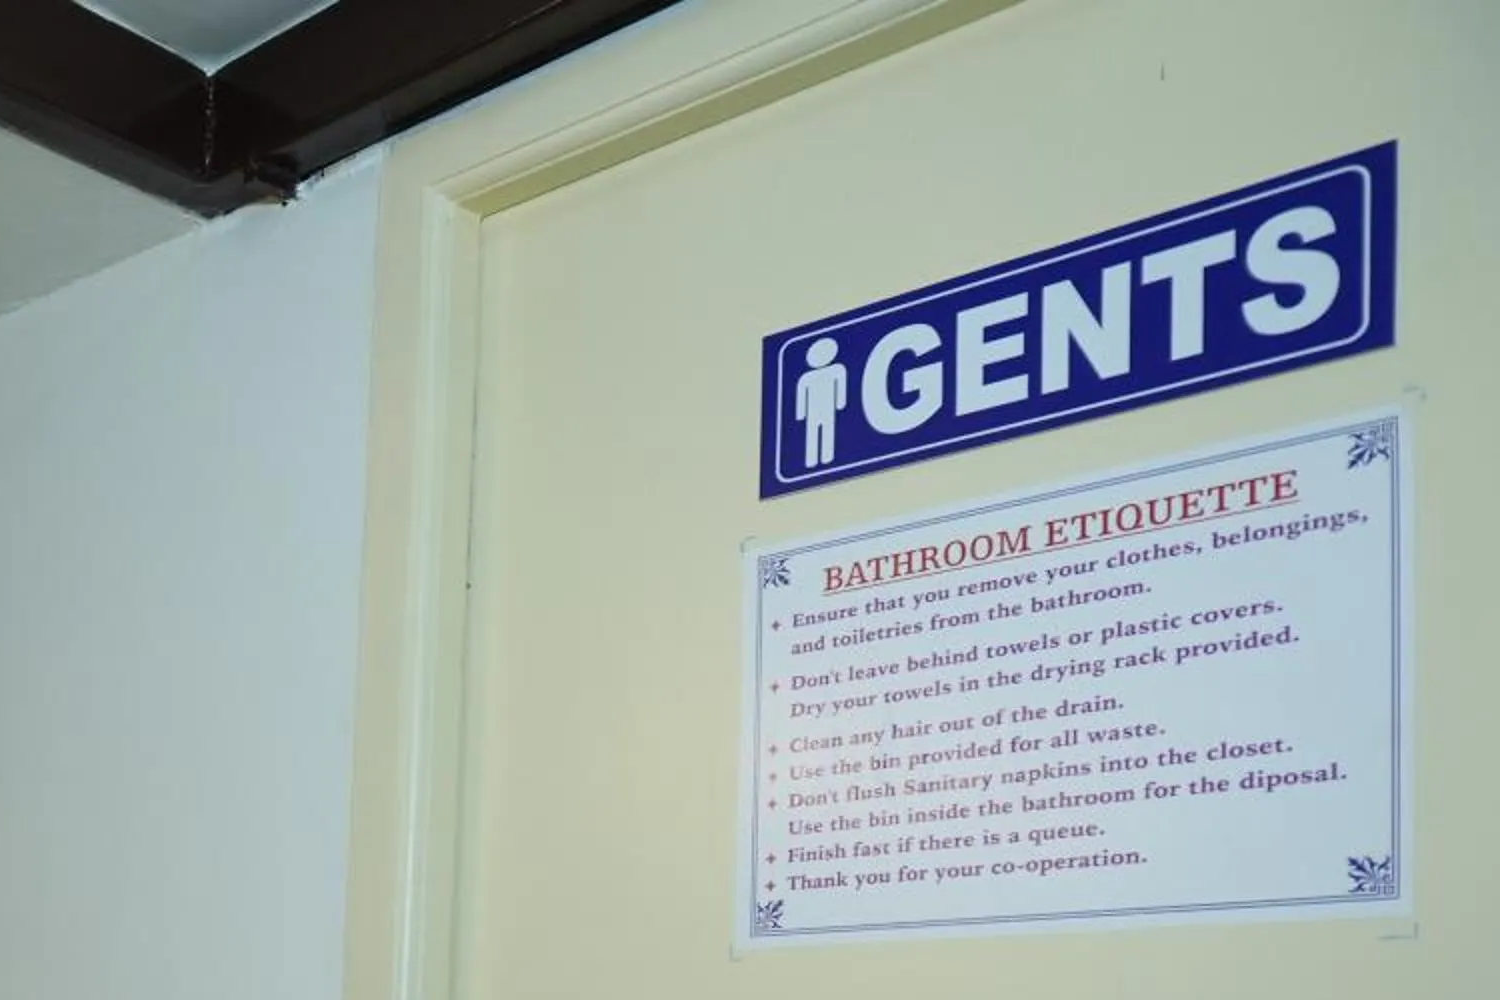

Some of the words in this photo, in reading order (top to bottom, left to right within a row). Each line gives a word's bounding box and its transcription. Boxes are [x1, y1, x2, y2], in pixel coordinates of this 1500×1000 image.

[861, 205, 1341, 435] GENTS
[823, 524, 1031, 592] BATHROOM
[1044, 468, 1298, 547] ETIQUETTE
[791, 606, 858, 628] Ensure
[864, 595, 904, 615] that
[912, 588, 950, 610] you
[956, 572, 1038, 597] remove
[1045, 559, 1098, 585] your
[1105, 542, 1202, 569] clothes,
[1211, 509, 1369, 549] belongings,
[790, 634, 825, 655] and
[831, 620, 923, 648] toiletries
[929, 611, 980, 631] from
[986, 601, 1022, 621] the
[1029, 581, 1152, 613] bathroom.
[847, 662, 899, 681] leave
[906, 644, 978, 673] behind
[985, 632, 1060, 659] towels
[1067, 630, 1093, 646] or
[1100, 612, 1181, 646] plastic
[1189, 601, 1283, 626] covers.
[789, 701, 826, 719] Dry
[831, 694, 877, 713] your
[882, 679, 952, 704] towels
[958, 675, 979, 693] in
[986, 670, 1022, 688] the
[1029, 658, 1105, 683] drying
[1113, 645, 1166, 669] rack
[1175, 624, 1300, 665] provided.
[788, 734, 843, 753] Clean
[848, 729, 885, 746] any
[890, 719, 932, 740] hair
[937, 716, 973, 733] out
[980, 708, 1003, 727] of
[1010, 704, 1047, 724] the
[1054, 694, 1124, 717] drain.
[788, 765, 824, 781] Use
[830, 758, 862, 775] the
[869, 752, 900, 771] bin
[908, 738, 1002, 771] provided
[1009, 734, 1042, 753] for
[1049, 728, 1078, 749] all
[1086, 722, 1165, 743] waste.
[787, 819, 823, 835] Use
[829, 814, 861, 832] the
[868, 809, 900, 828] bin
[906, 802, 970, 824] inside
[977, 798, 1013, 817] the
[1020, 788, 1135, 812] bathroom
[1143, 780, 1181, 800] for
[1187, 775, 1230, 795] the
[1238, 761, 1347, 793] diposal.
[845, 781, 896, 801] flush
[903, 773, 993, 794] Sanitary
[1000, 760, 1091, 786] napkins
[1099, 754, 1149, 773] into
[1156, 747, 1197, 767] the
[1205, 738, 1293, 762] closet.
[786, 870, 848, 891] Thank
[853, 871, 891, 890] you
[897, 864, 928, 883] for
[933, 863, 985, 884] your
[990, 848, 1147, 877] co-operation.
[787, 842, 846, 863] Finish
[852, 840, 890, 858] fast
[897, 835, 914, 853] if
[918, 833, 975, 851] there
[982, 832, 1001, 845] is
[1007, 830, 1020, 844] a
[1027, 823, 1105, 846] queue.
